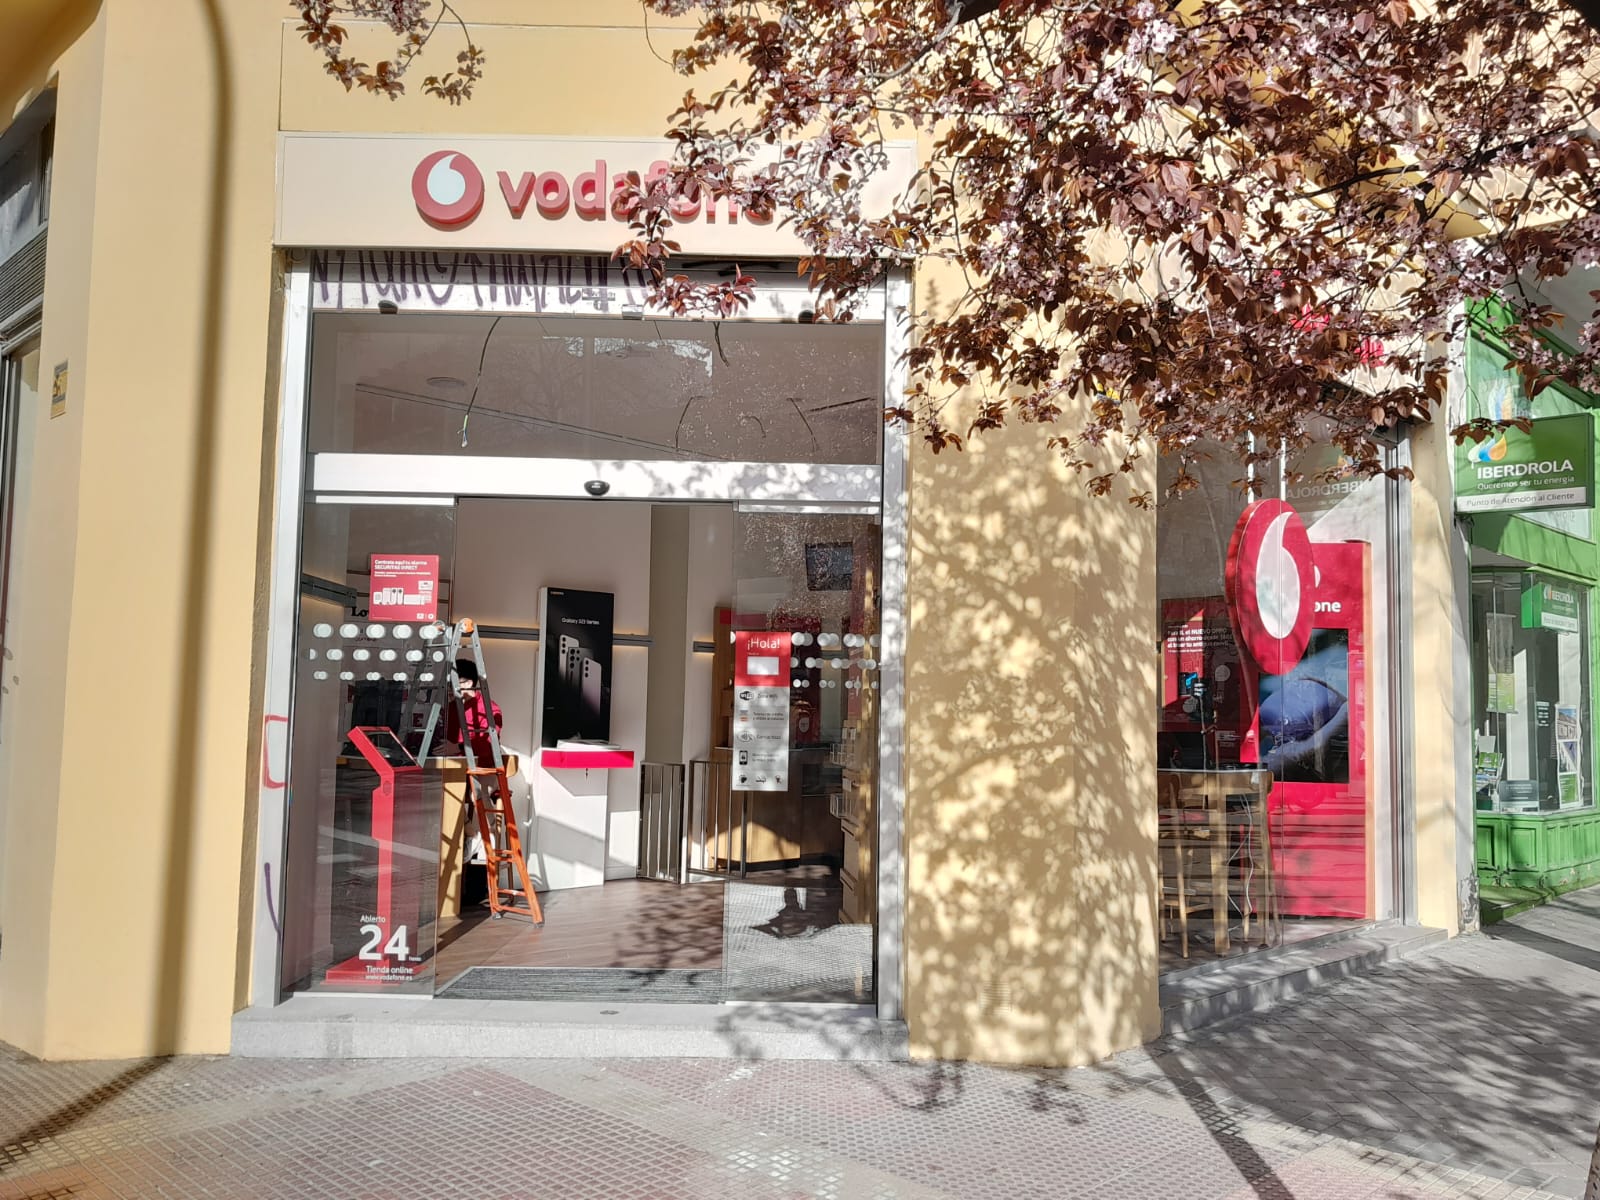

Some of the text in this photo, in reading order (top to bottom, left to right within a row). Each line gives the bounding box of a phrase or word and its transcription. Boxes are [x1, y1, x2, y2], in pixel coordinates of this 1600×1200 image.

[497, 159, 774, 225] vodafn
[1477, 459, 1573, 479] IBERDROLA
[1477, 479, 1517, 491] Queremos
[1519, 477, 1531, 487] ser
[1533, 477, 1543, 486] tu
[1466, 497, 1490, 507] Punto
[1490, 497, 1499, 505] de
[1537, 493, 1545, 502] al
[1546, 492, 1575, 502] Cliente
[747, 636, 780, 651] ¡Hola!
[360, 915, 386, 923] Abierto
[359, 924, 410, 961] 24
[366, 965, 414, 974] Tienda online
